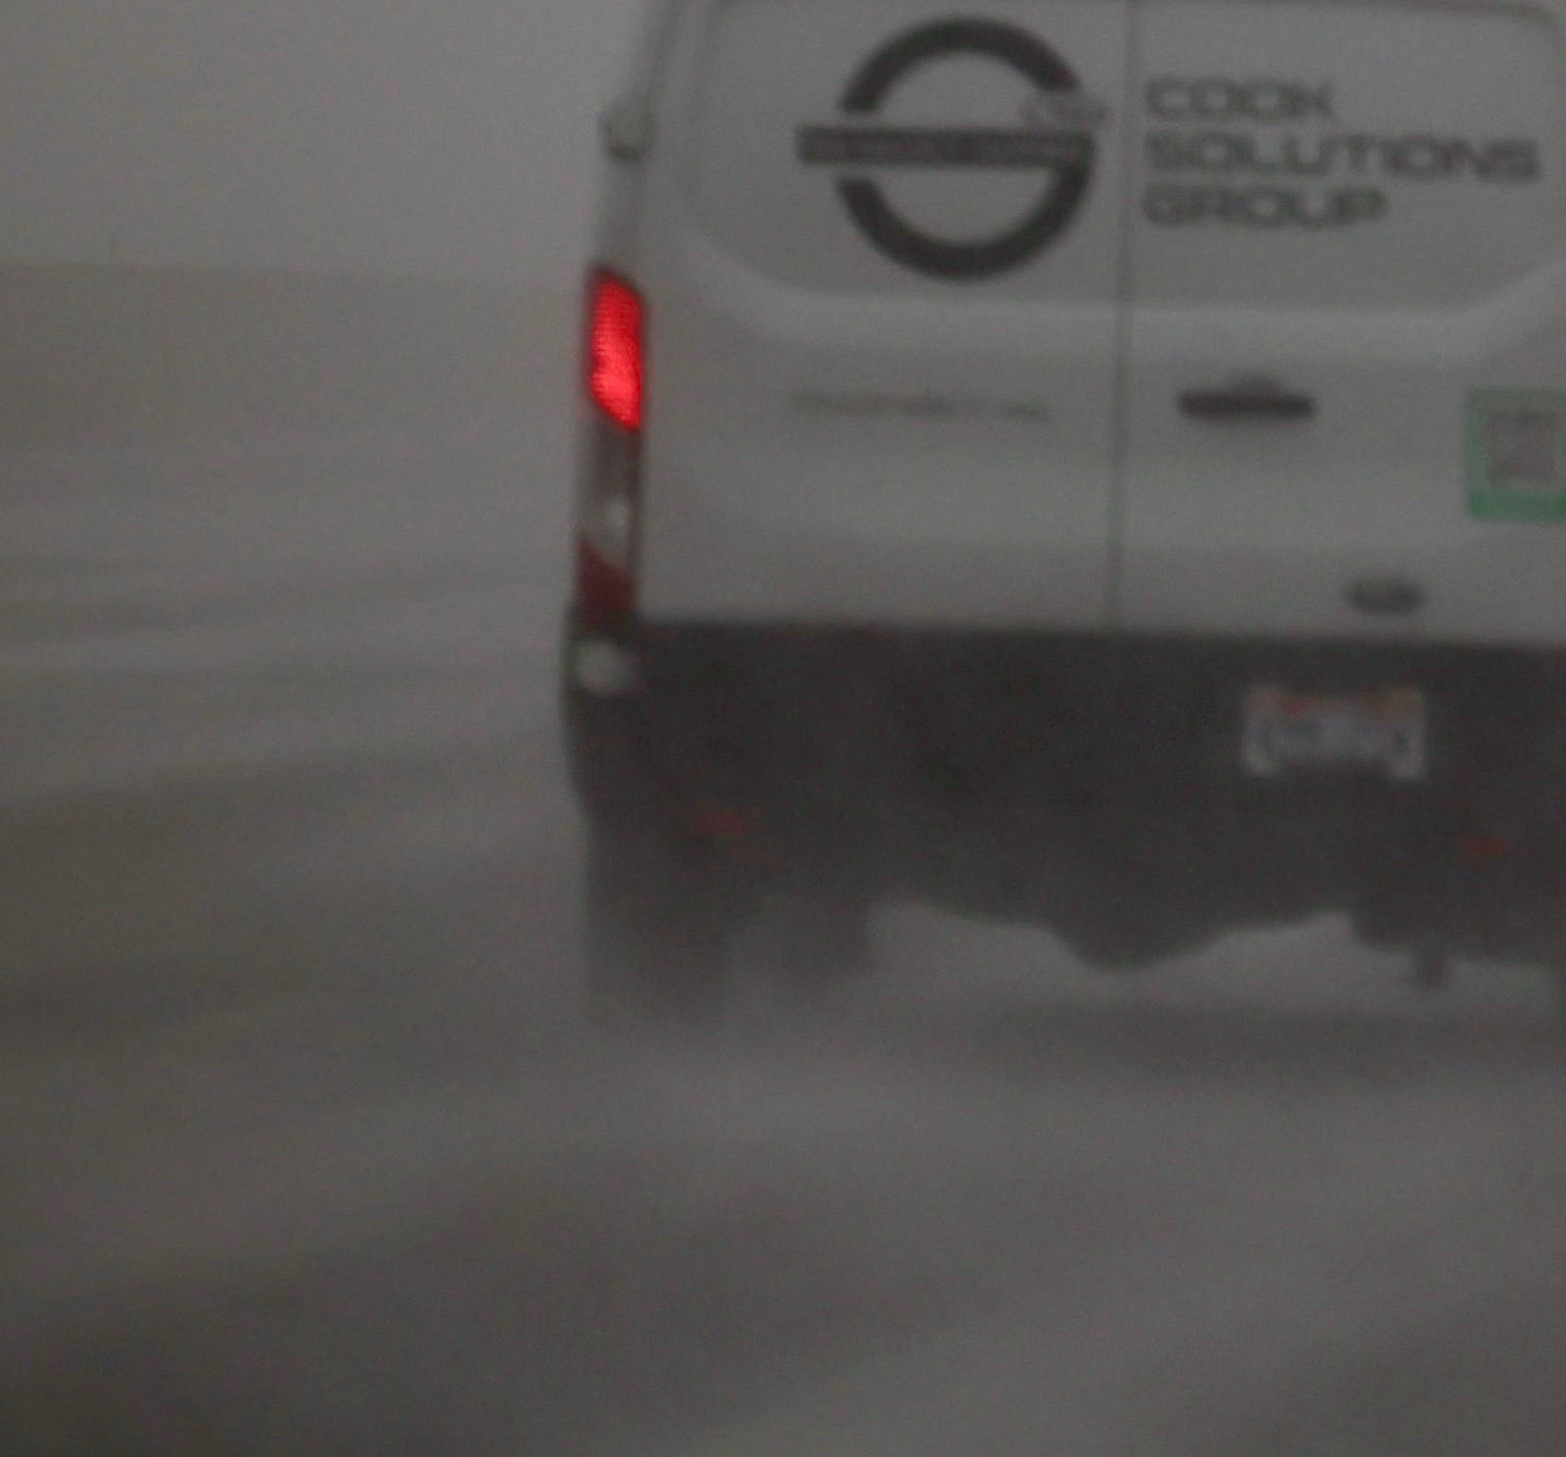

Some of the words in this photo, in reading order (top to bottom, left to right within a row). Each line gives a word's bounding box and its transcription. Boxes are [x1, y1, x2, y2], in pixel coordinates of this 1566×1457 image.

[1145, 77, 1337, 121] COOK
[1145, 130, 1543, 183] SOLUTIONS
[1143, 183, 1390, 228] GROUP
